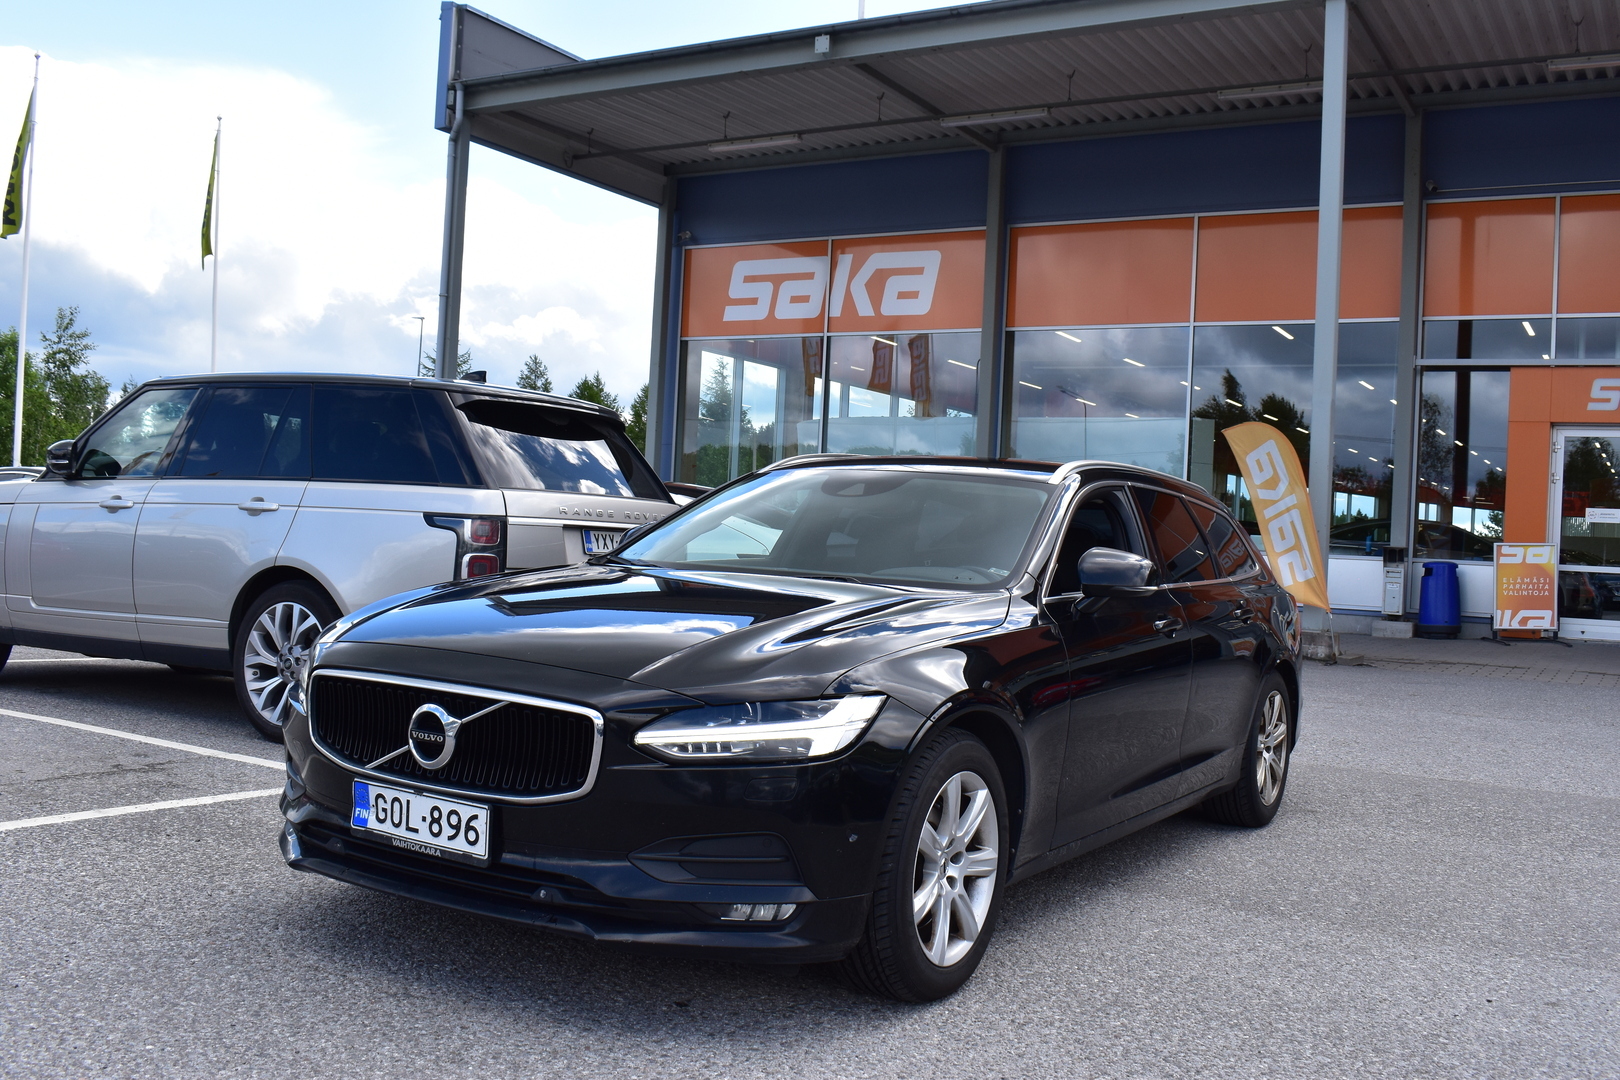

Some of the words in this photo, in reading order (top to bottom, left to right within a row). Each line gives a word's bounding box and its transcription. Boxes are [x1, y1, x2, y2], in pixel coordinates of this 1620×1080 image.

[559, 507, 615, 518] RANGE
[412, 731, 443, 742] VOLVO
[355, 807, 369, 820] FIN
[375, 793, 480, 846] GOL-896
[392, 838, 441, 857] VAIHTOKAARA
